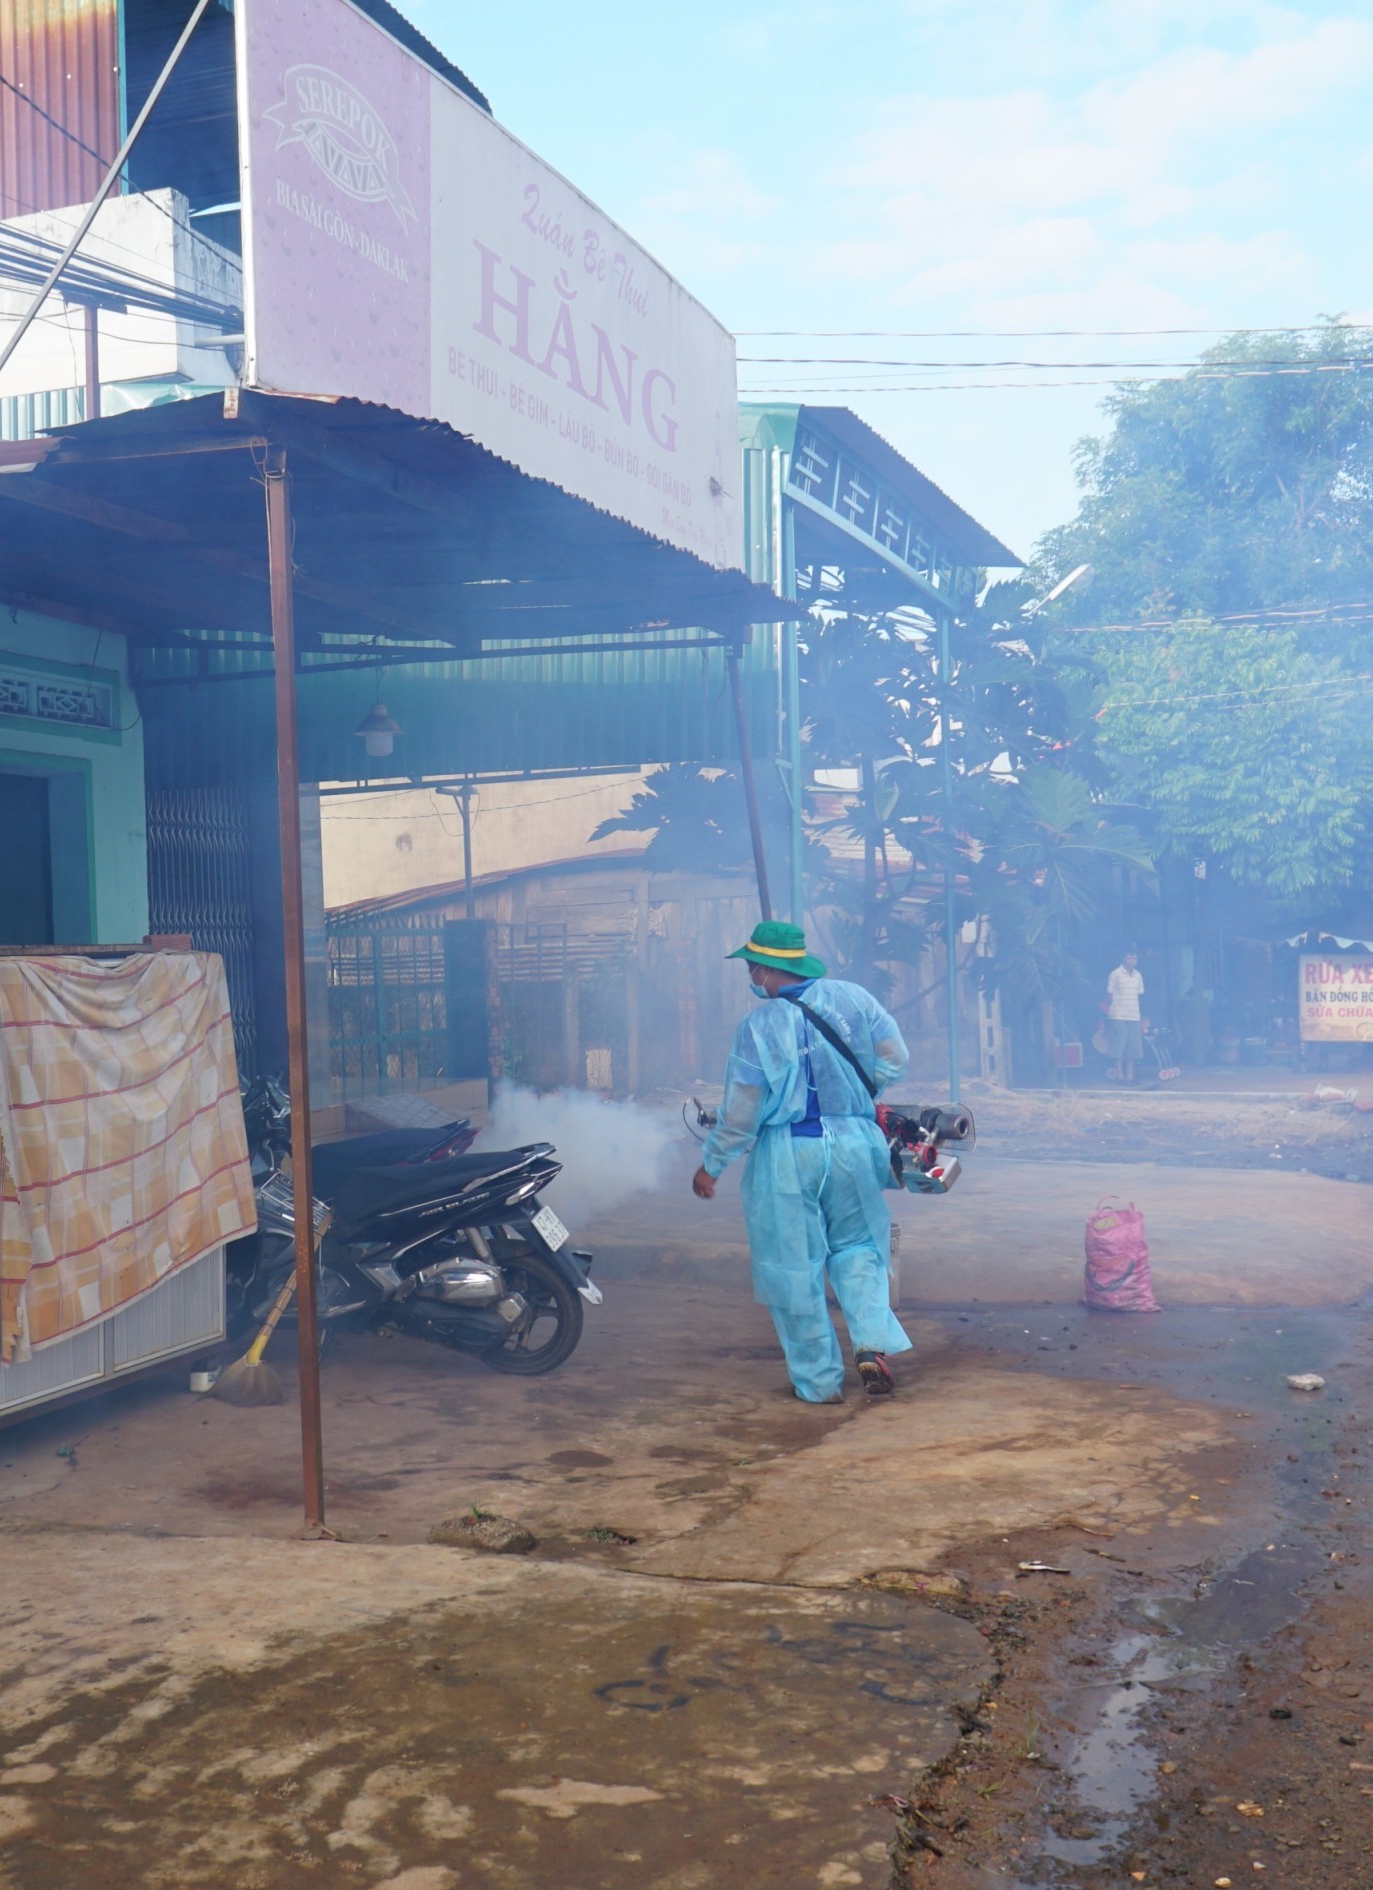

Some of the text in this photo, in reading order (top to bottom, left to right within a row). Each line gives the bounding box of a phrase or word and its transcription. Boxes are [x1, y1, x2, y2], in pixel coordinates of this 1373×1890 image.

[296, 76, 392, 175] SEREPOK
[521, 183, 575, 260] Quán
[614, 251, 649, 318] Thui
[469, 356, 498, 400] THUI
